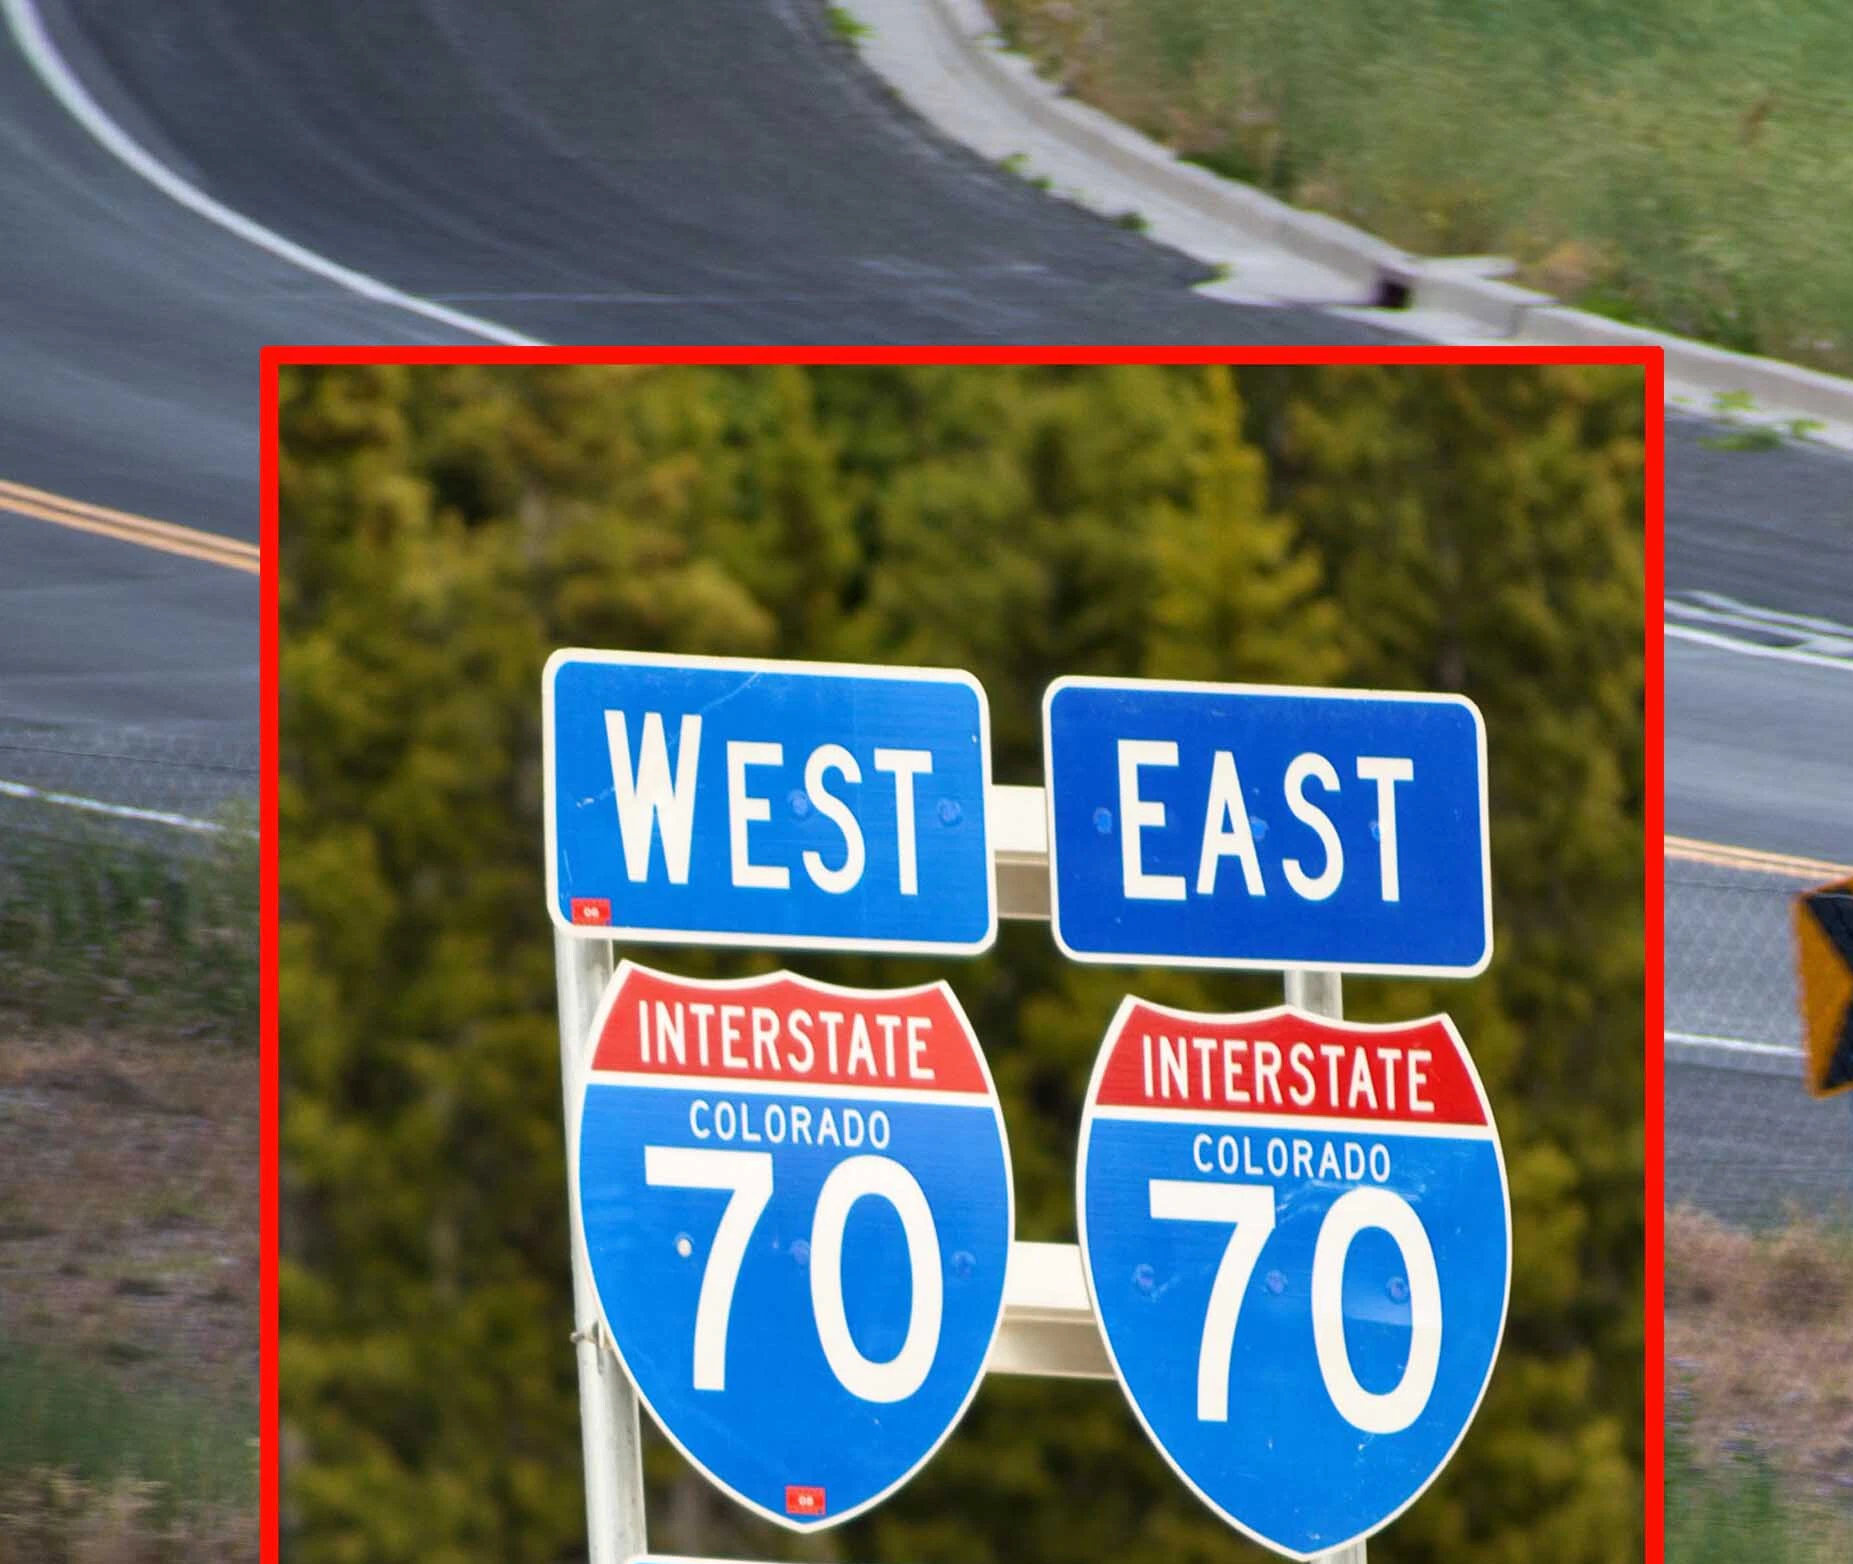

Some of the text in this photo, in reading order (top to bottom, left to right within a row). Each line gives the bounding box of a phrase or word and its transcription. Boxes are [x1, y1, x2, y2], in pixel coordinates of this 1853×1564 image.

[605, 710, 932, 895] WEST
[1116, 740, 1413, 902] EAST
[637, 1000, 935, 1080] INTERSTATE
[1142, 1034, 1434, 1112] INTERSTATE
[689, 1099, 889, 1149] COLORADO
[1193, 1134, 1390, 1182] COLORADO
[644, 1146, 944, 1403] 70
[1149, 1179, 1443, 1435] 70
